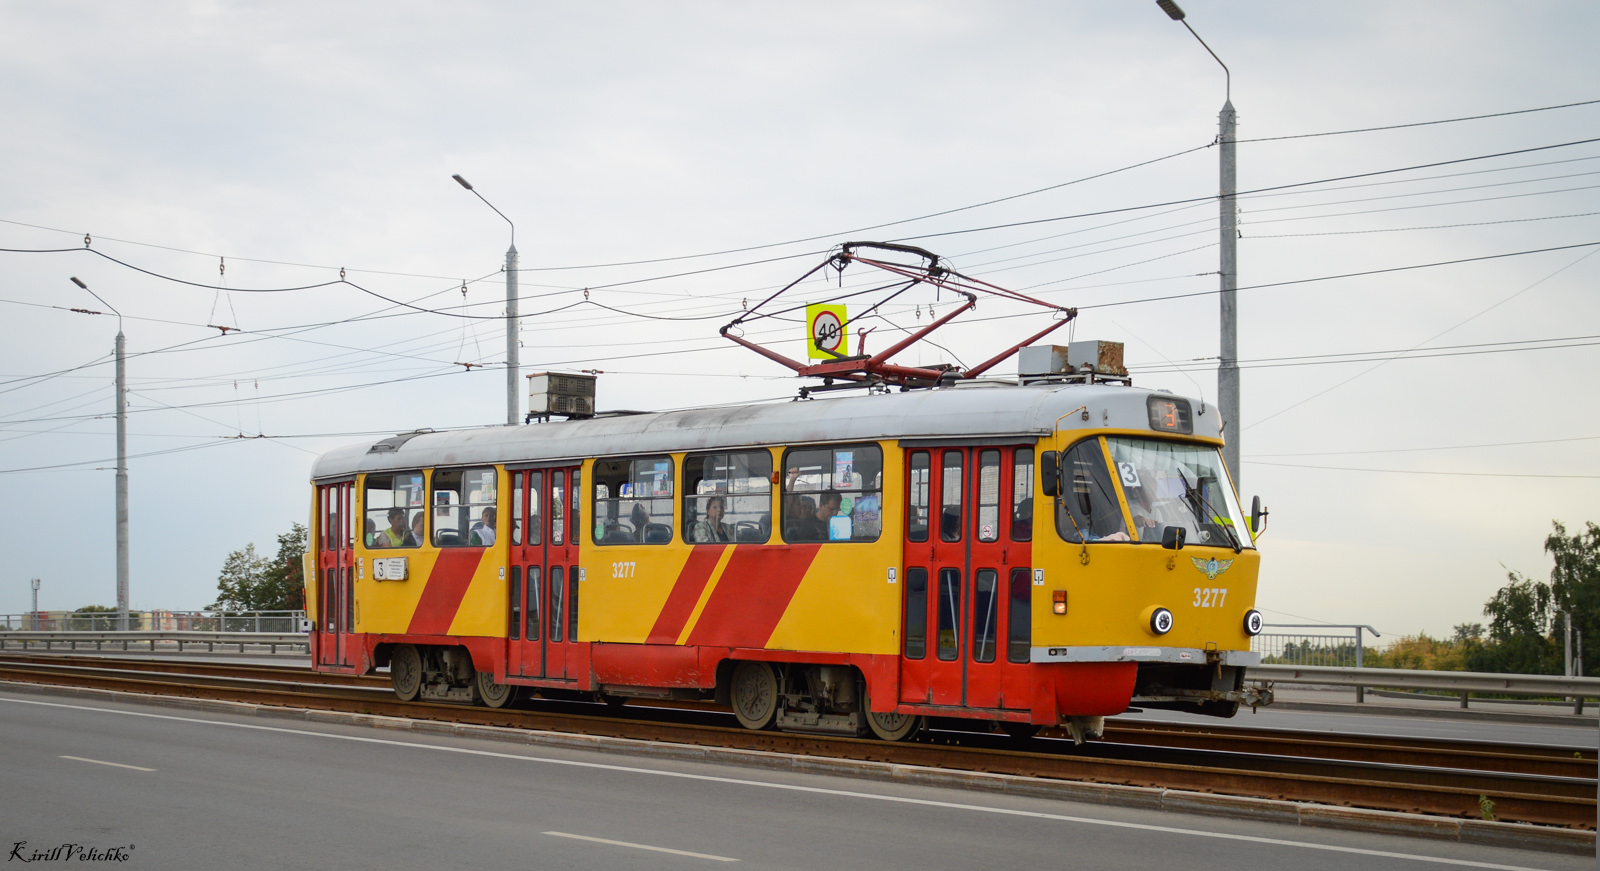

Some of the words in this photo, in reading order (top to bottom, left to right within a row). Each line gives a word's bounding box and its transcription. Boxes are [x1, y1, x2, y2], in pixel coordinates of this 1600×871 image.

[818, 323, 837, 340] 40
[1165, 404, 1175, 427] 3
[1121, 463, 1137, 483] 3
[378, 562, 384, 577] 3
[612, 561, 636, 578] 3277
[1192, 587, 1228, 608] 3277
